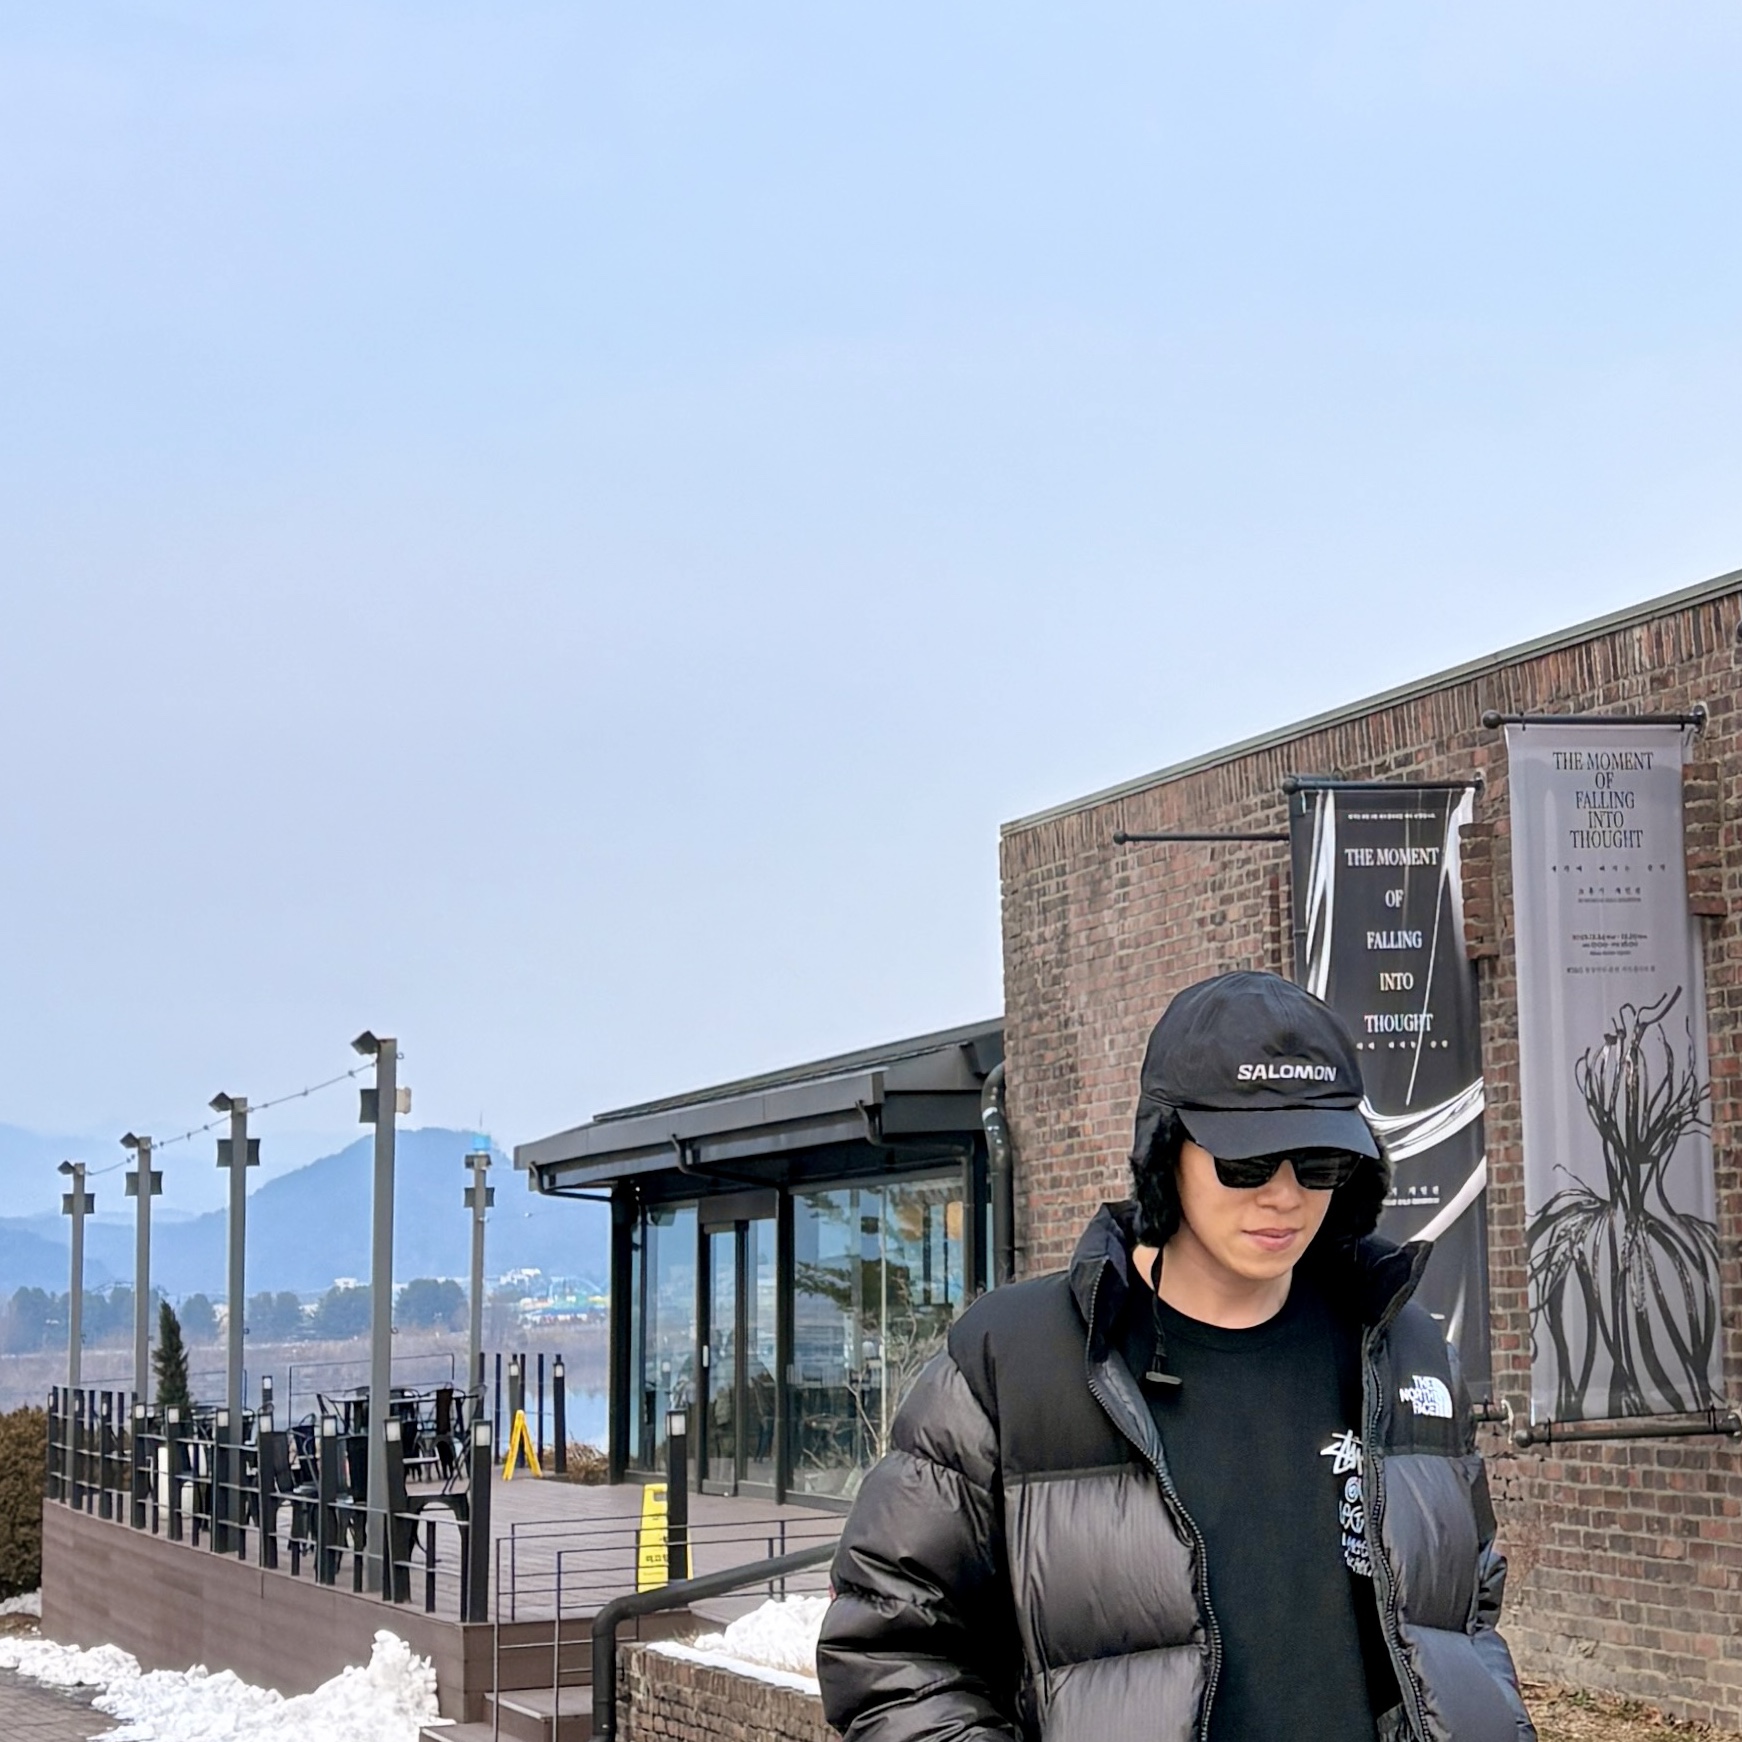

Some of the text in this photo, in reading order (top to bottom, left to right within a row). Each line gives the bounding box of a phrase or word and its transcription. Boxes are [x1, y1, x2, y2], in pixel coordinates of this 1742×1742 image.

[1553, 752, 1654, 770] THE MOMENT
[1595, 772, 1614, 789] OF
[1576, 791, 1635, 809] FALLING
[1588, 811, 1624, 829] INTO
[1570, 830, 1643, 848] THOUGHT
[1345, 847, 1439, 866] THE MOMENT
[1385, 890, 1404, 908] OF
[1367, 931, 1422, 950] FALLING
[1380, 973, 1414, 991] INTO
[1364, 1014, 1433, 1033] THOUGHT
[1237, 1063, 1337, 1081] SALOMON
[1412, 1375, 1433, 1389] THE
